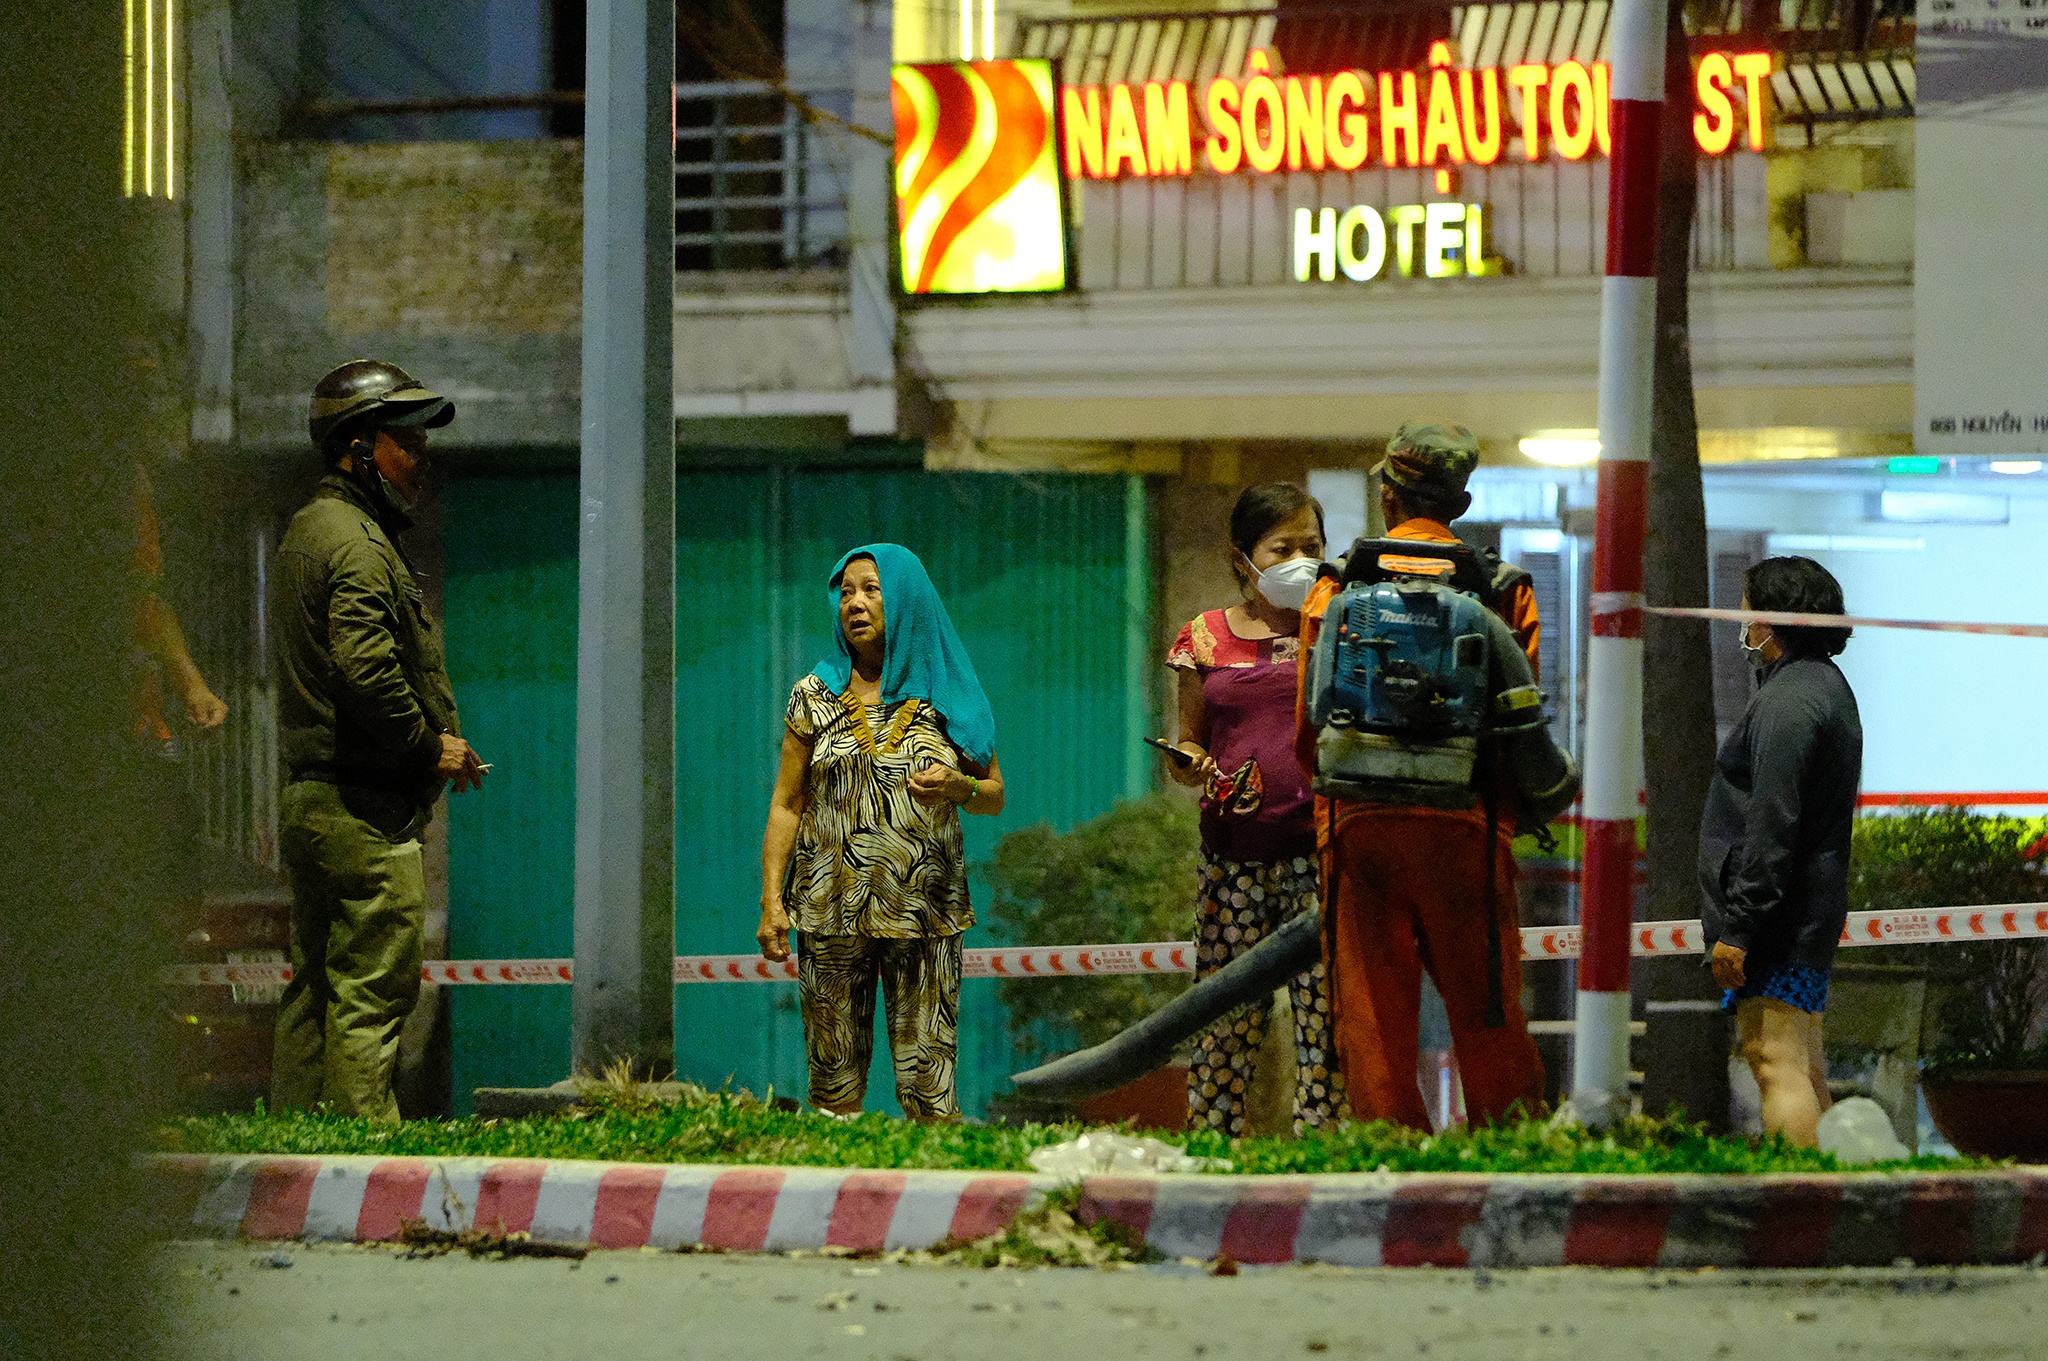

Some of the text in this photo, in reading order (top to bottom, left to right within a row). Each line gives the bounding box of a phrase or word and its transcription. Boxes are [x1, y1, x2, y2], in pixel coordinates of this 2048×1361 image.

[1061, 40, 1772, 194] NAM SÔNG HẬU TOST
[1293, 202, 1498, 282] HOTEL
